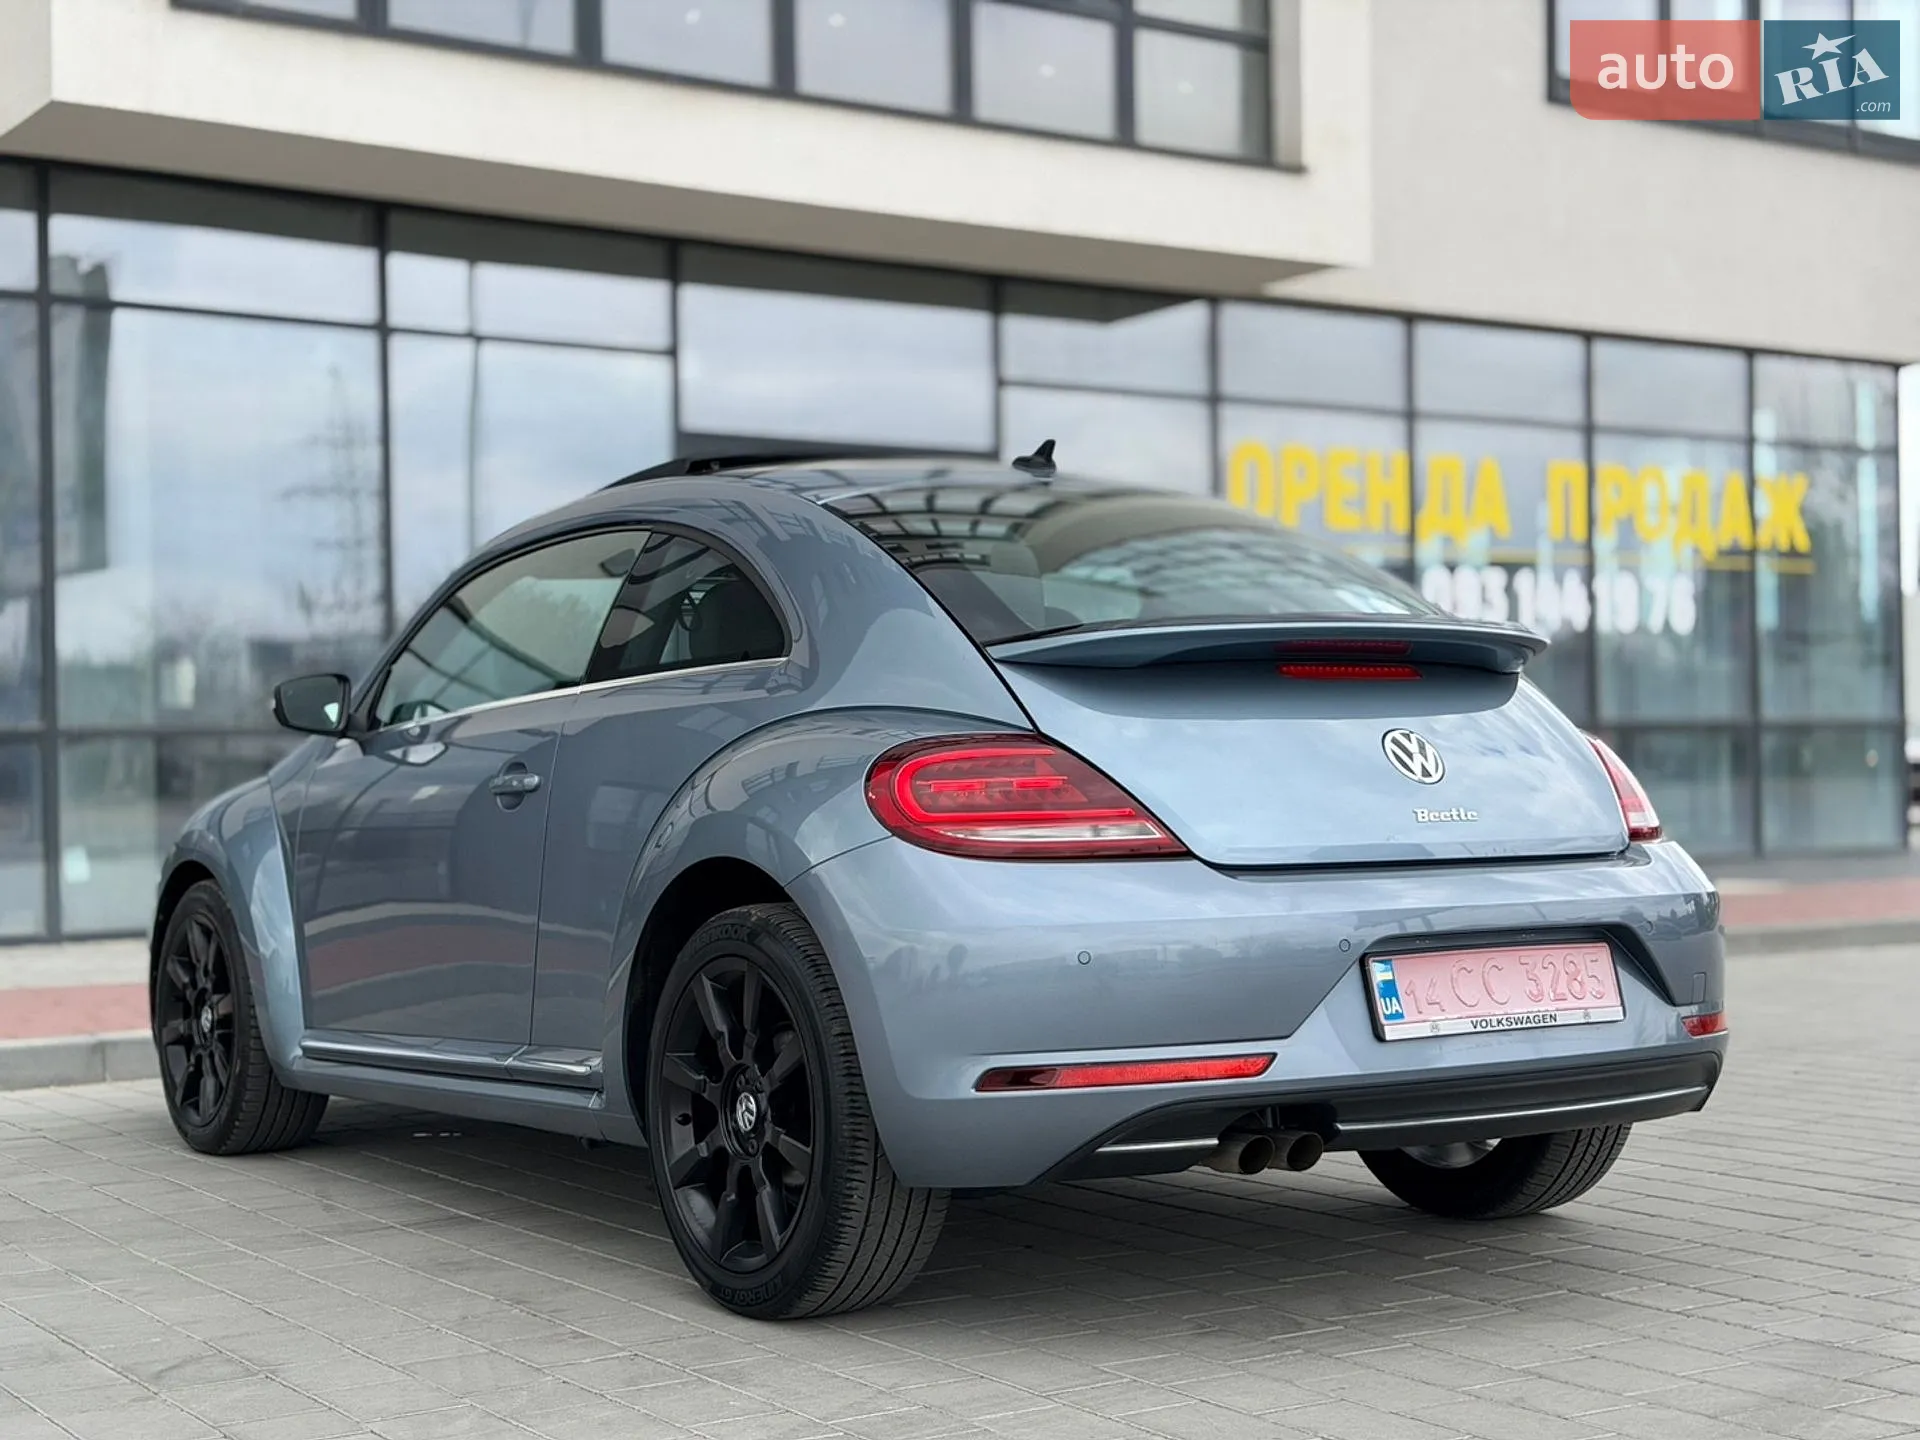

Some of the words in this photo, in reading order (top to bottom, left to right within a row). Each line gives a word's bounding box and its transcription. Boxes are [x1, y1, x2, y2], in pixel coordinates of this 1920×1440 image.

[1226, 439, 1512, 549] ОРЕНДА
[1546, 460, 1812, 561] ПРОДАЖ
[1413, 807, 1480, 823] Beetle
[1405, 976, 1446, 1014] 14
[1518, 951, 1607, 1003] 3285
[1380, 997, 1402, 1015] UA
[1470, 1012, 1558, 1030] VOLKSWAGEN
